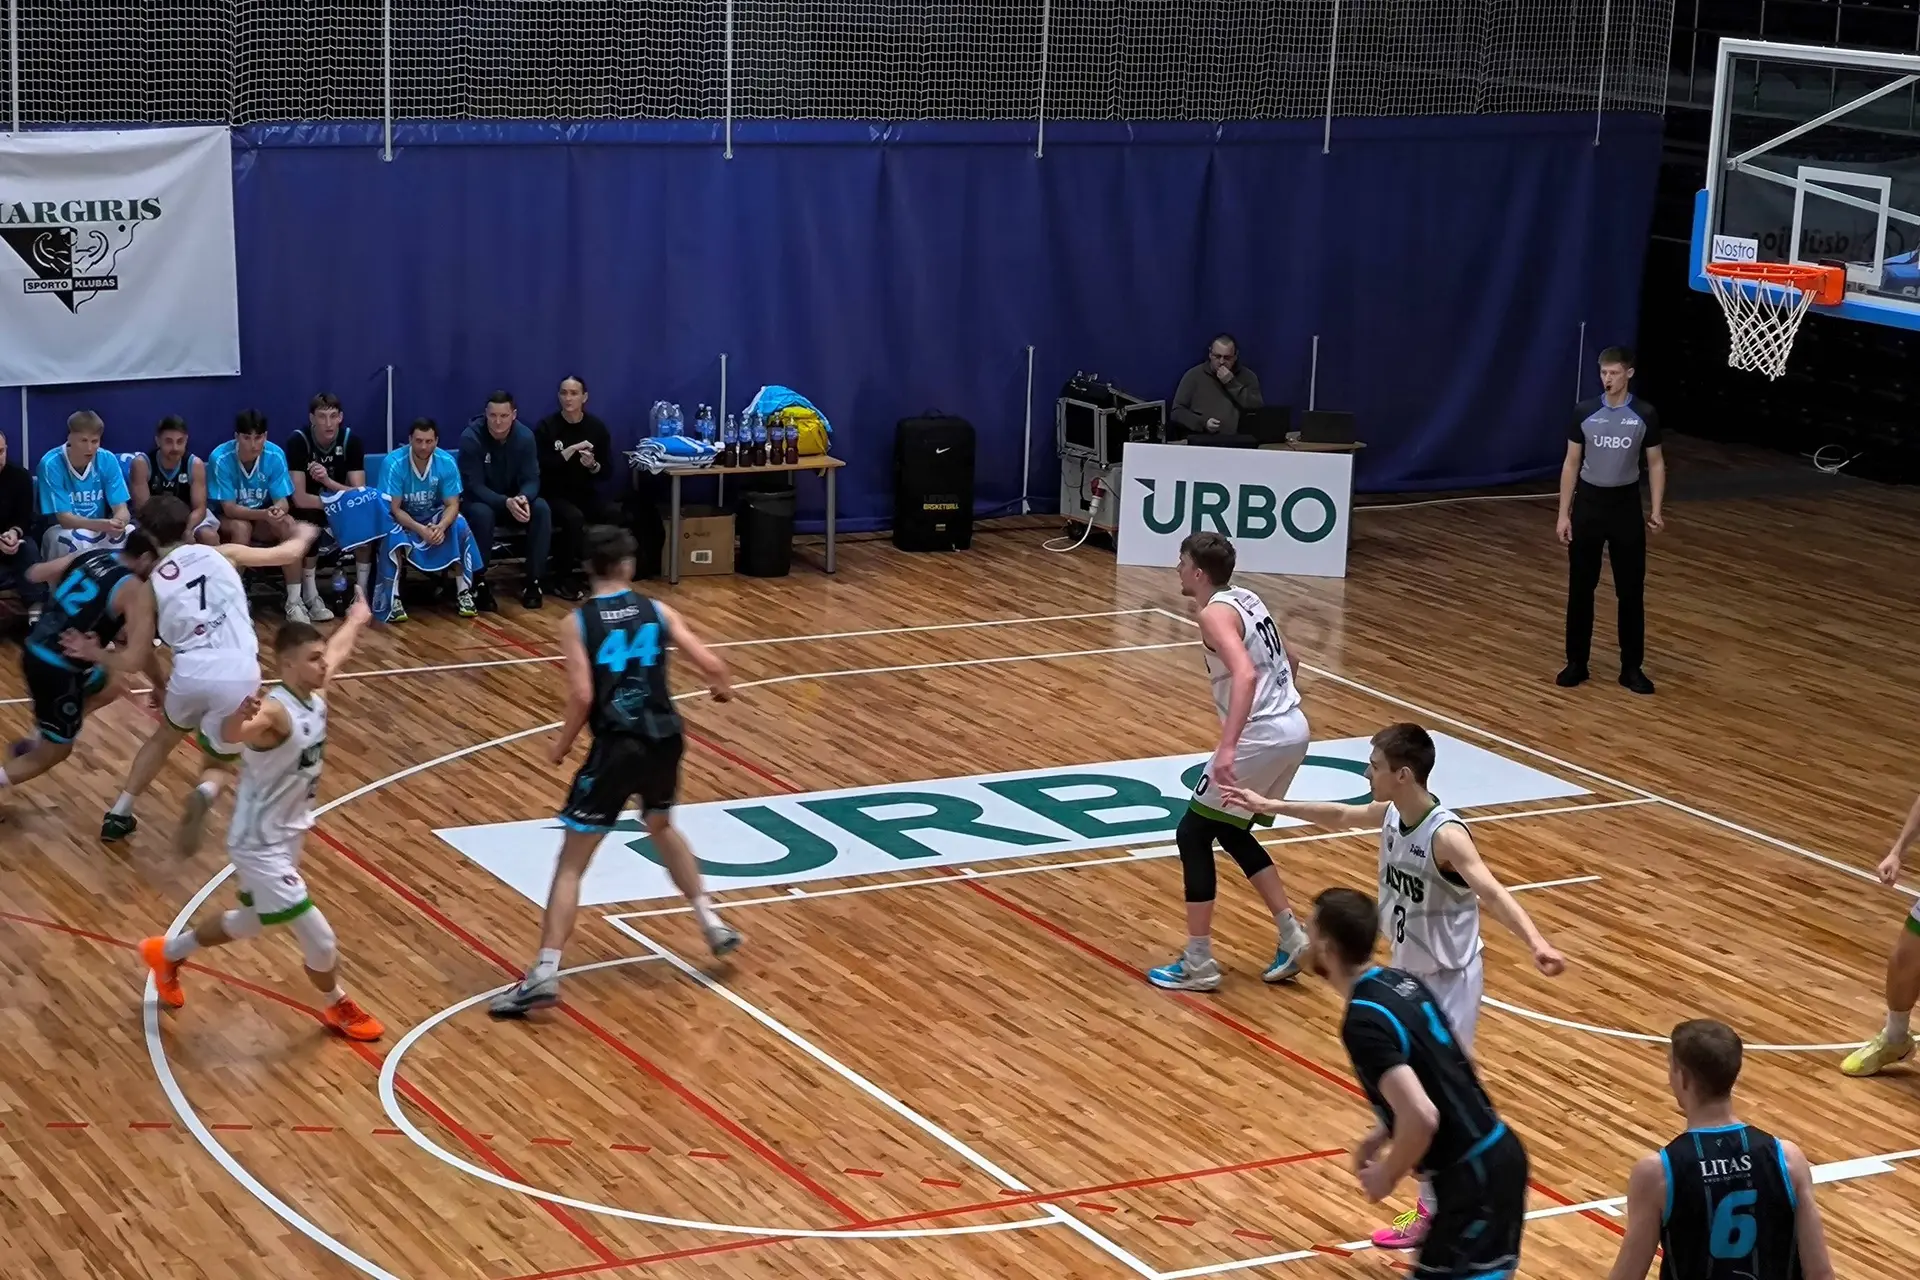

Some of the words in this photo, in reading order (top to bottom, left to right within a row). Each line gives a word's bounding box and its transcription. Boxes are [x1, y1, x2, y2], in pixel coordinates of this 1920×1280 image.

[0, 197, 162, 224] ARGIRIS
[1714, 239, 1755, 259] Nostra
[27, 281, 69, 290] SPORTO
[75, 278, 116, 288] KLUBAS
[1593, 435, 1632, 449] URBO
[1134, 477, 1337, 544] URBO
[185, 574, 207, 612] 7
[596, 622, 661, 673] 44
[1699, 1155, 1752, 1177] LITAS
[1709, 1189, 1758, 1259] 6
